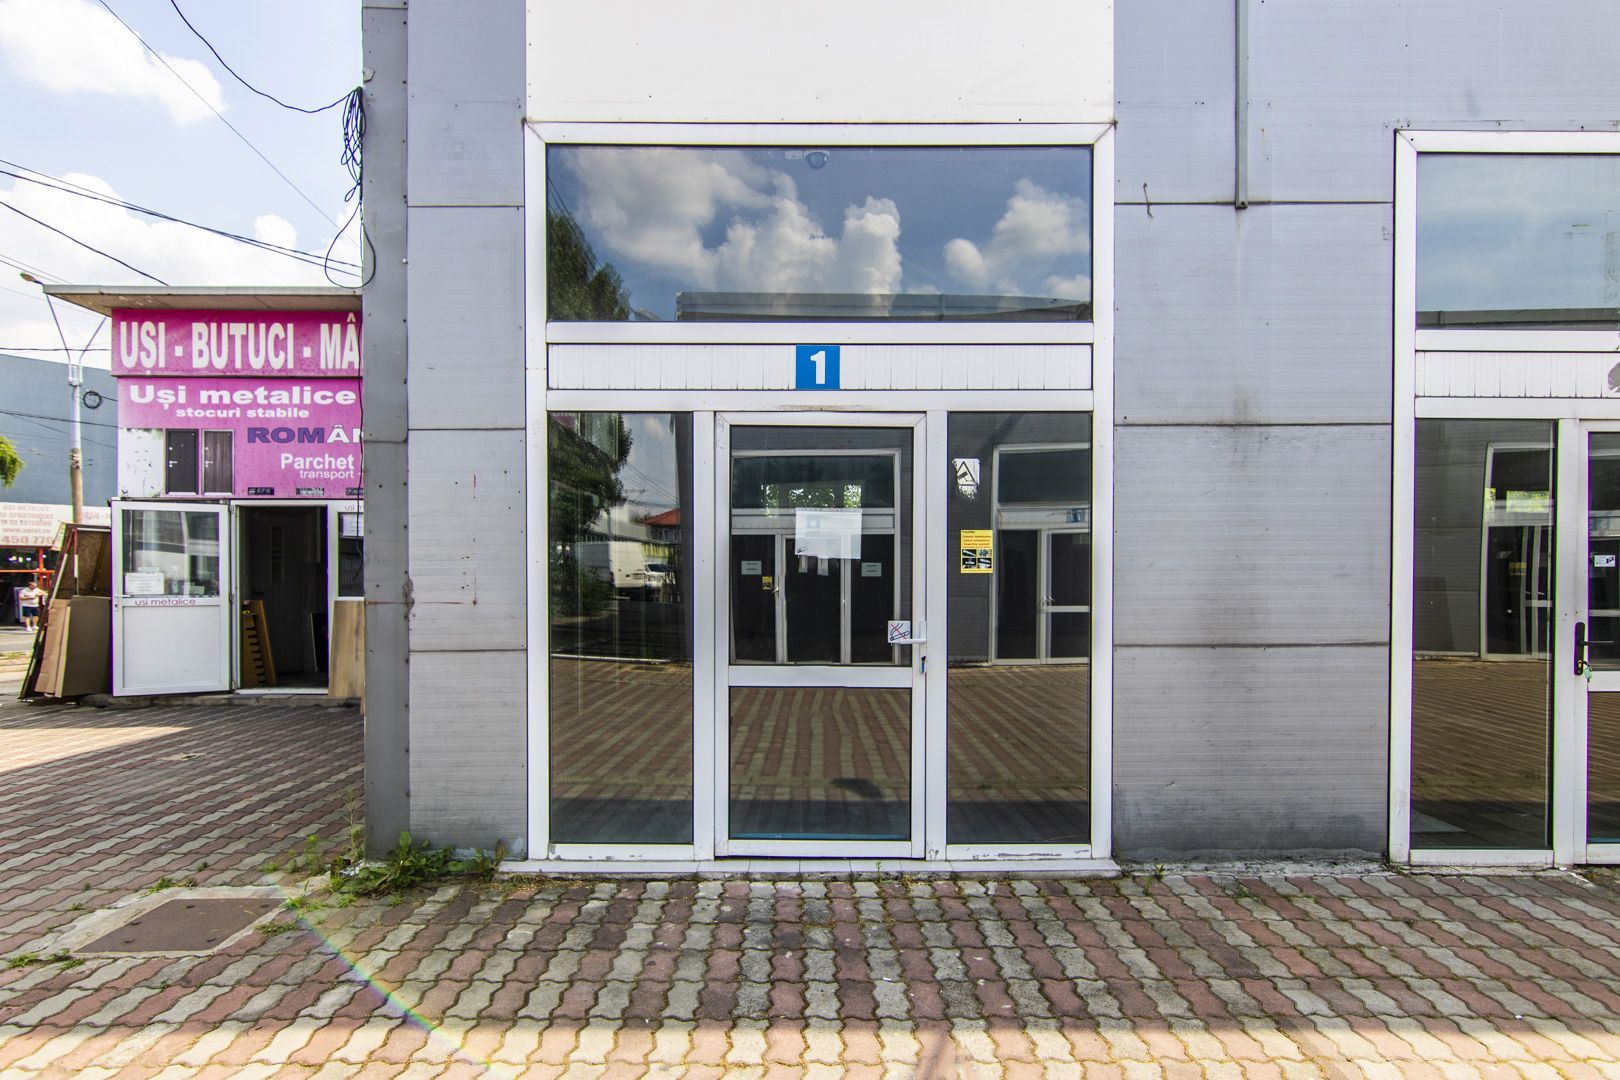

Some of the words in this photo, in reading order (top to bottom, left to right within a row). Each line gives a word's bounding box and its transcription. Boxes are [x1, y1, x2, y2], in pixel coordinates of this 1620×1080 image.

[192, 322, 294, 370] BUTUCI
[320, 312, 363, 369] MÂ
[810, 350, 826, 385] 1
[200, 386, 356, 405] metalice
[176, 407, 241, 418] stocuri
[246, 407, 310, 418] stabile
[280, 453, 355, 470] Parchet
[300, 469, 354, 481] transport
[150, 598, 196, 606] metalice
